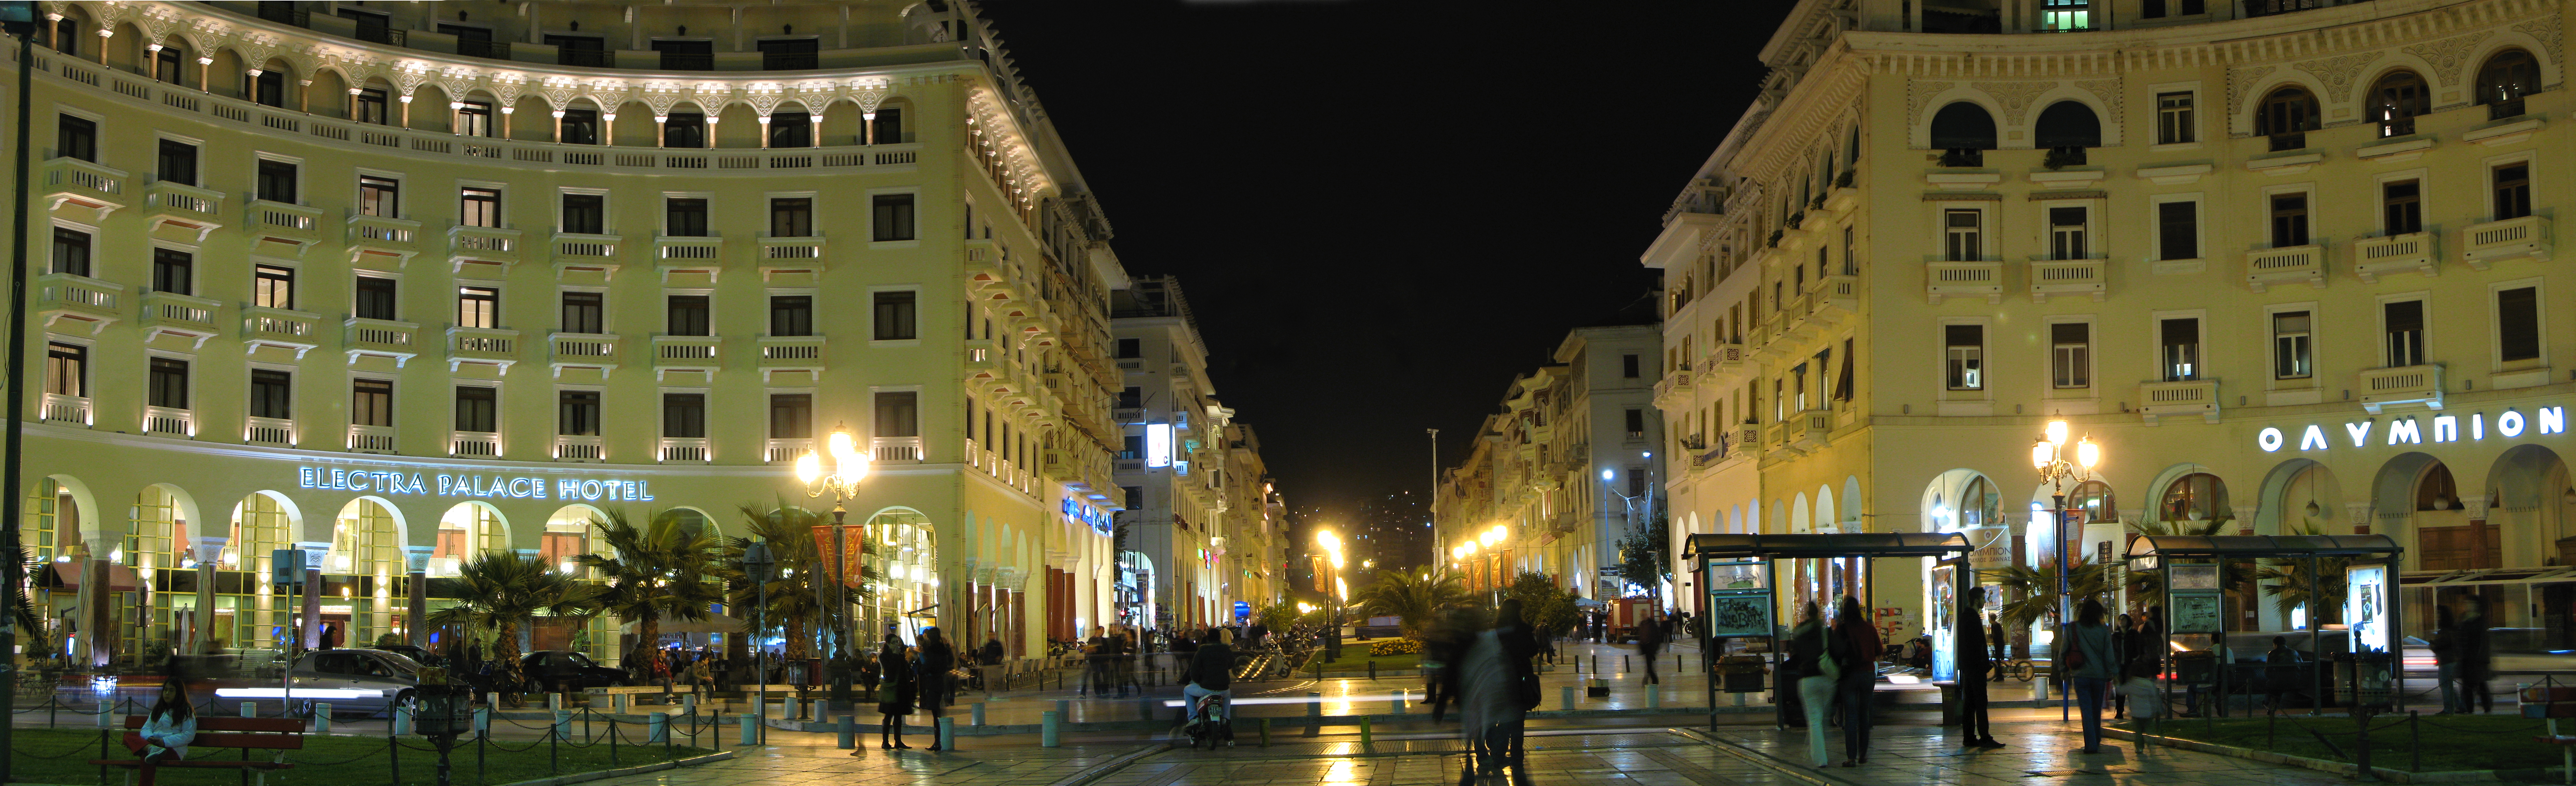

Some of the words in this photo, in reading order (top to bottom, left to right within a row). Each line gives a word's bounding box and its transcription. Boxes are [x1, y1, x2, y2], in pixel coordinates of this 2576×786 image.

[2258, 406, 2565, 452] ΟΛΥΜΠΙΟΝ
[300, 467, 427, 494] ELECTRA
[438, 474, 546, 499] PALACE
[559, 479, 654, 501] HOTEL
[824, 536, 836, 581] ΔΗΜΗΤΡΙΑ
